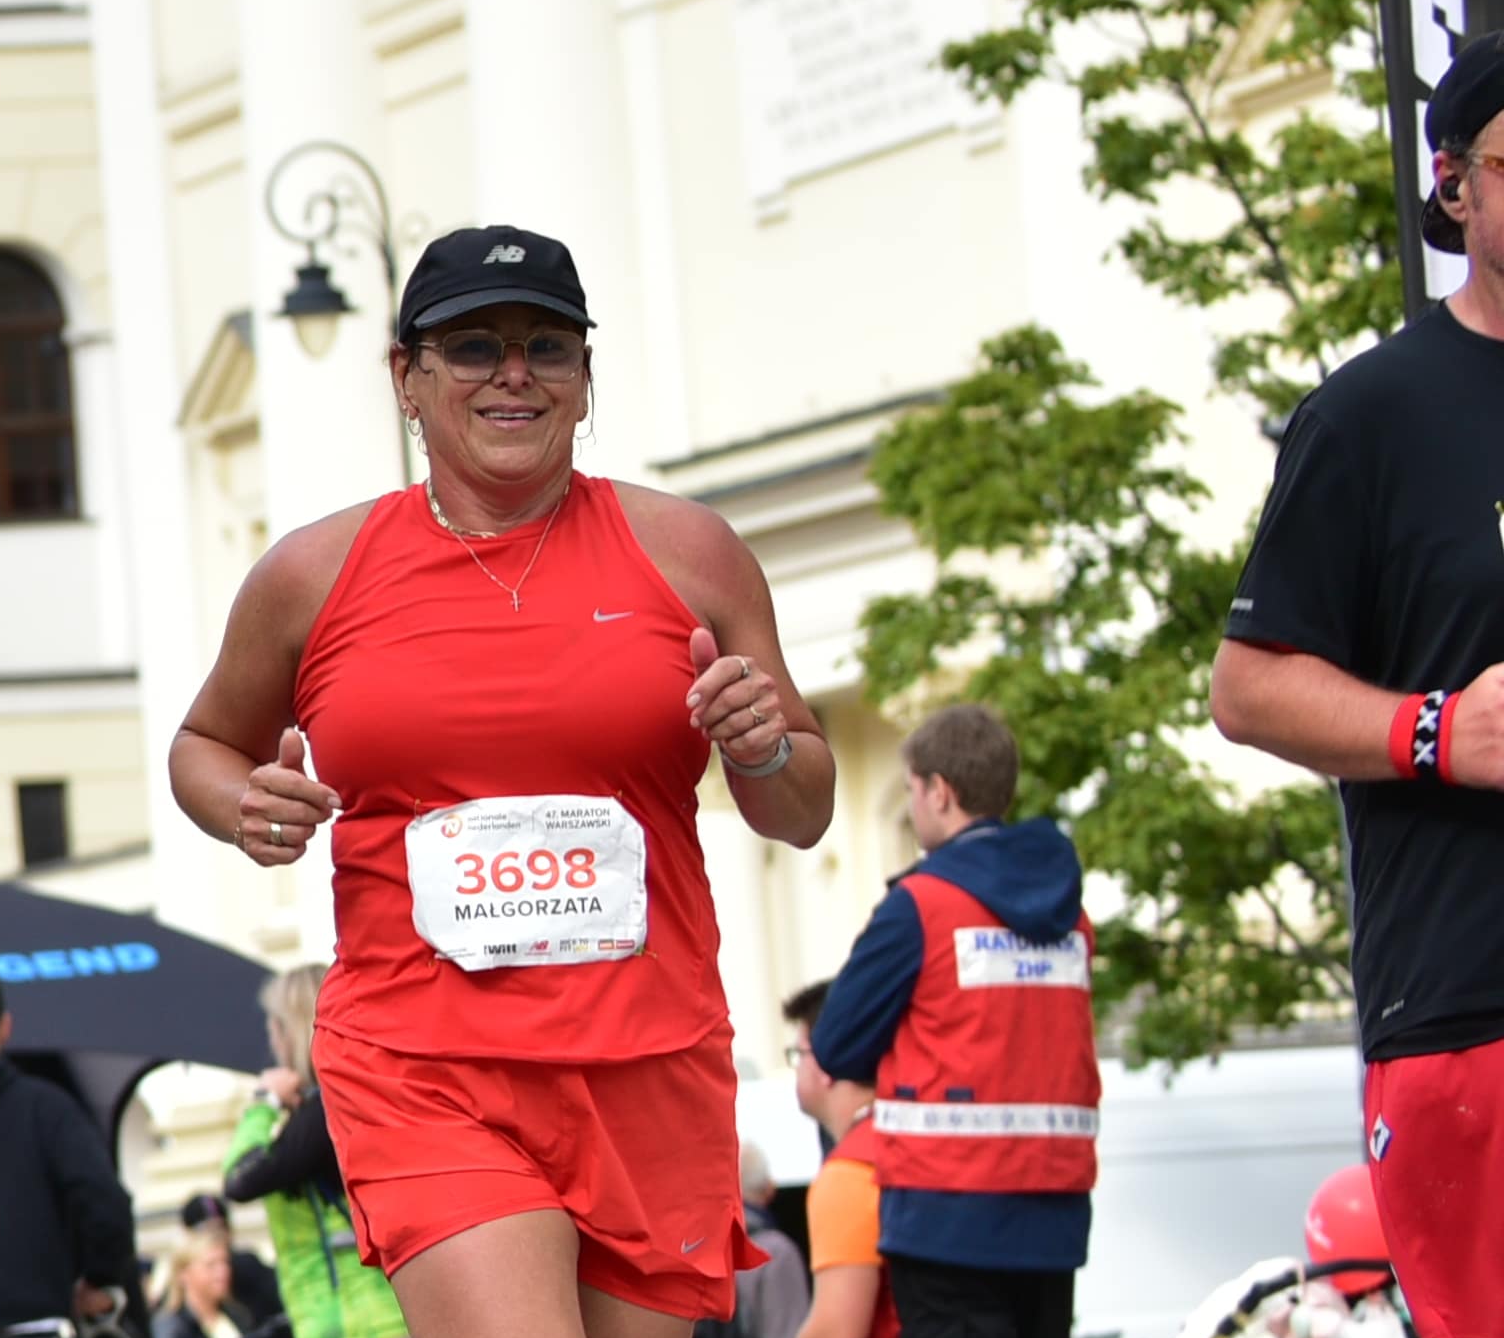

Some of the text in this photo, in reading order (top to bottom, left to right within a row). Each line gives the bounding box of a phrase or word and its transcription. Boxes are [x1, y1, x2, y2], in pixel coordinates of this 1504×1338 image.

[545, 808, 611, 820] 47. MARATON
[545, 819, 611, 830] WARSZAWSKI
[454, 848, 597, 895] 3698
[454, 896, 603, 921] MAŁGORZATA
